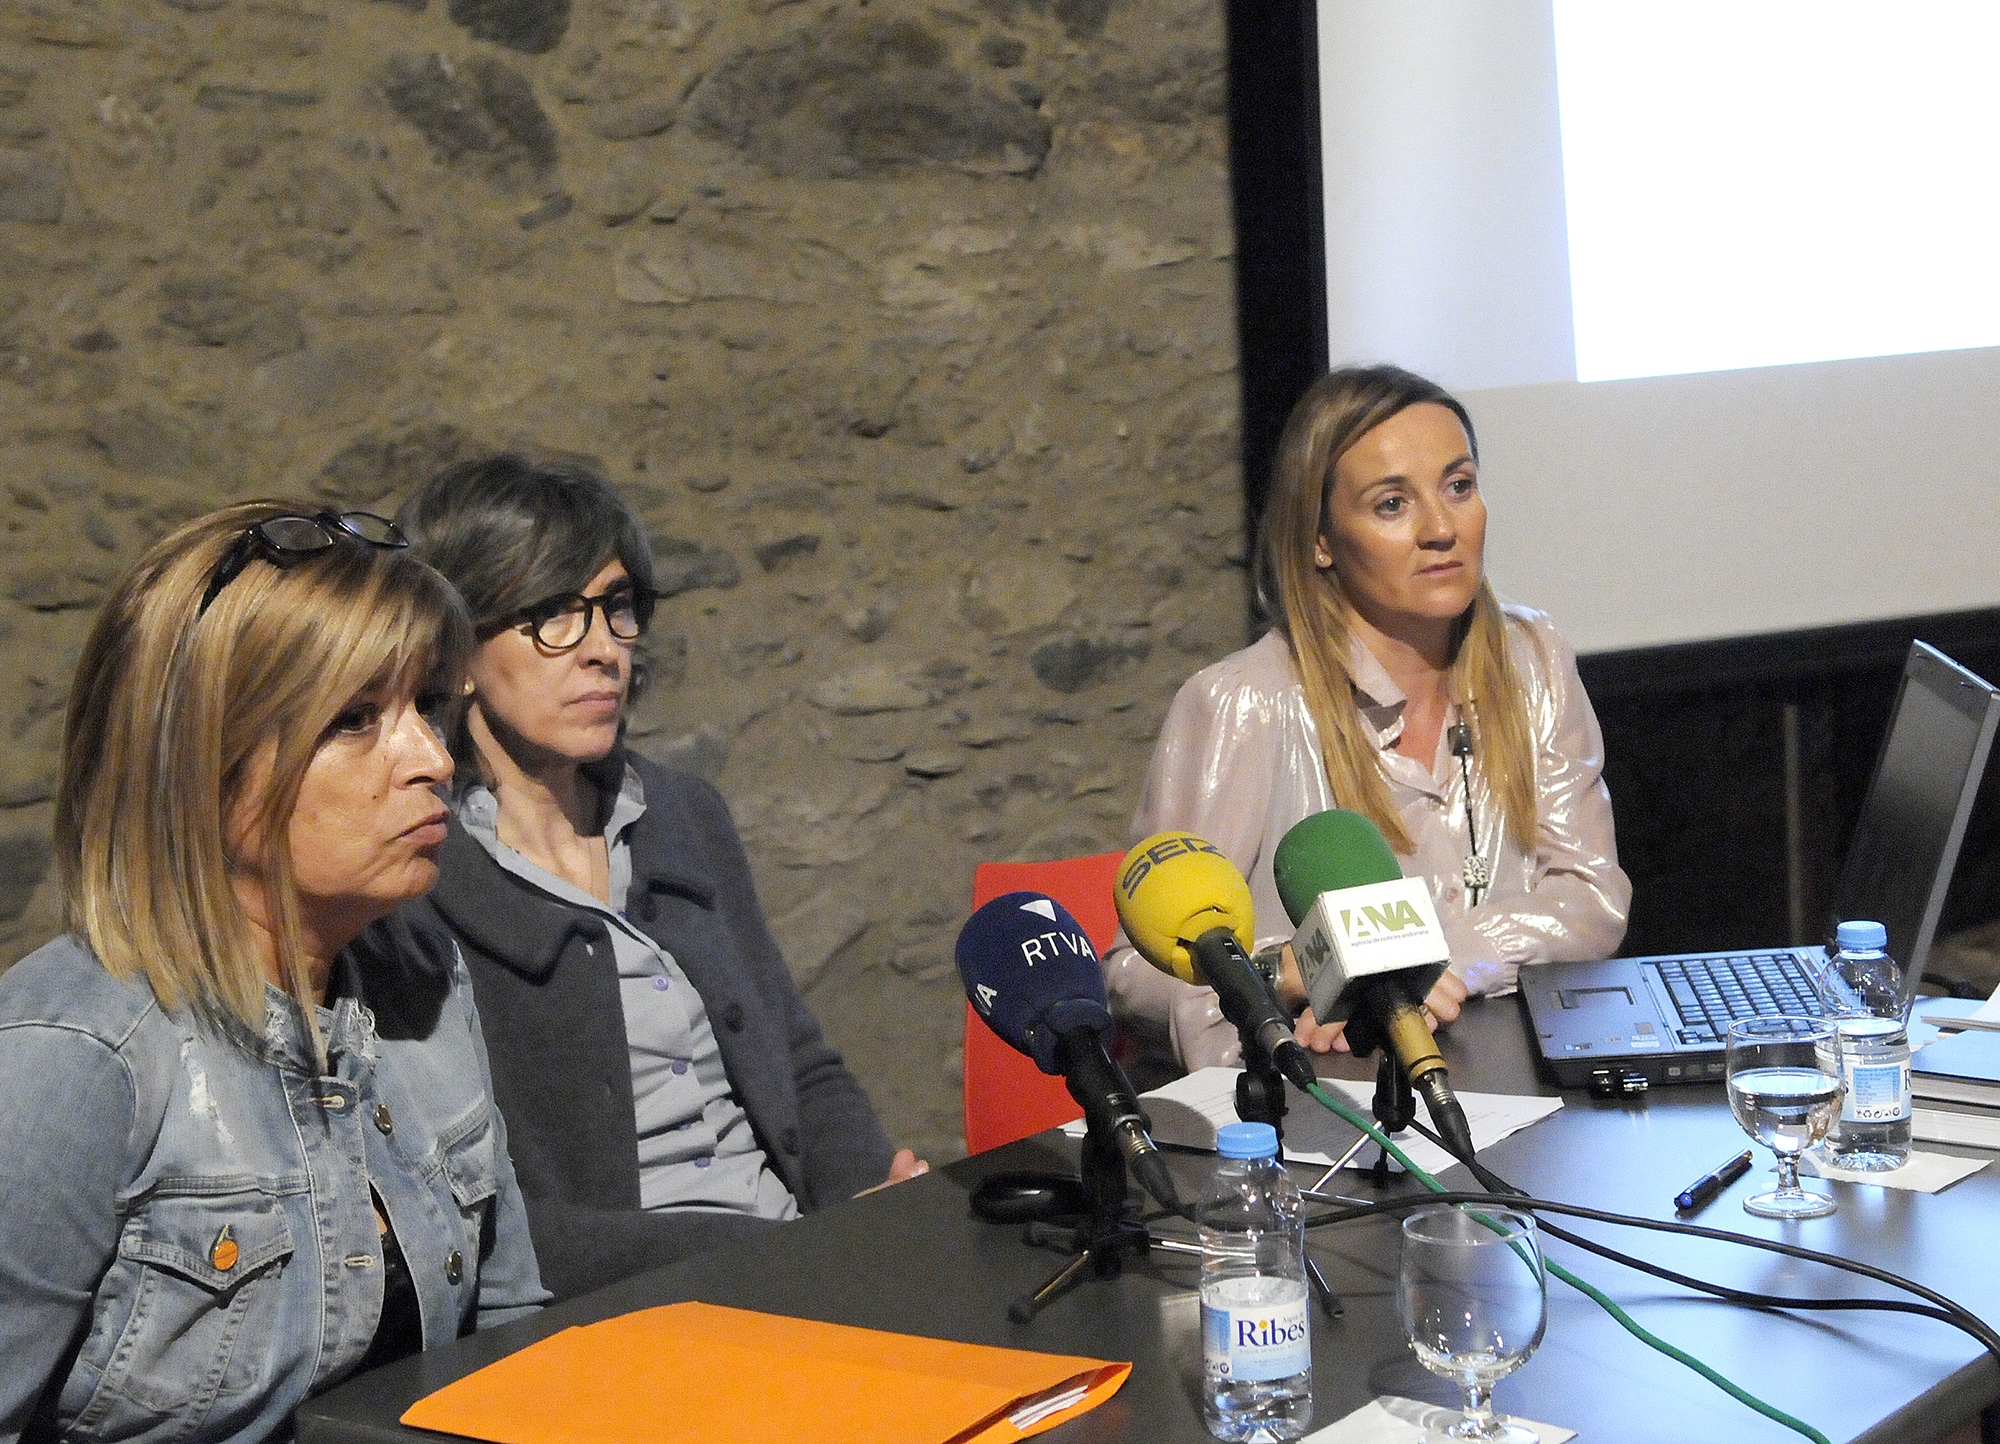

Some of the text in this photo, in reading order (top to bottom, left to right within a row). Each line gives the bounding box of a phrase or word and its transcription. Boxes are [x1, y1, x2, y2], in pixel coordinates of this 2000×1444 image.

[1339, 900, 1426, 938] ANA
[1021, 931, 1097, 967] RTVA
[1235, 1318, 1305, 1348] Ribes
